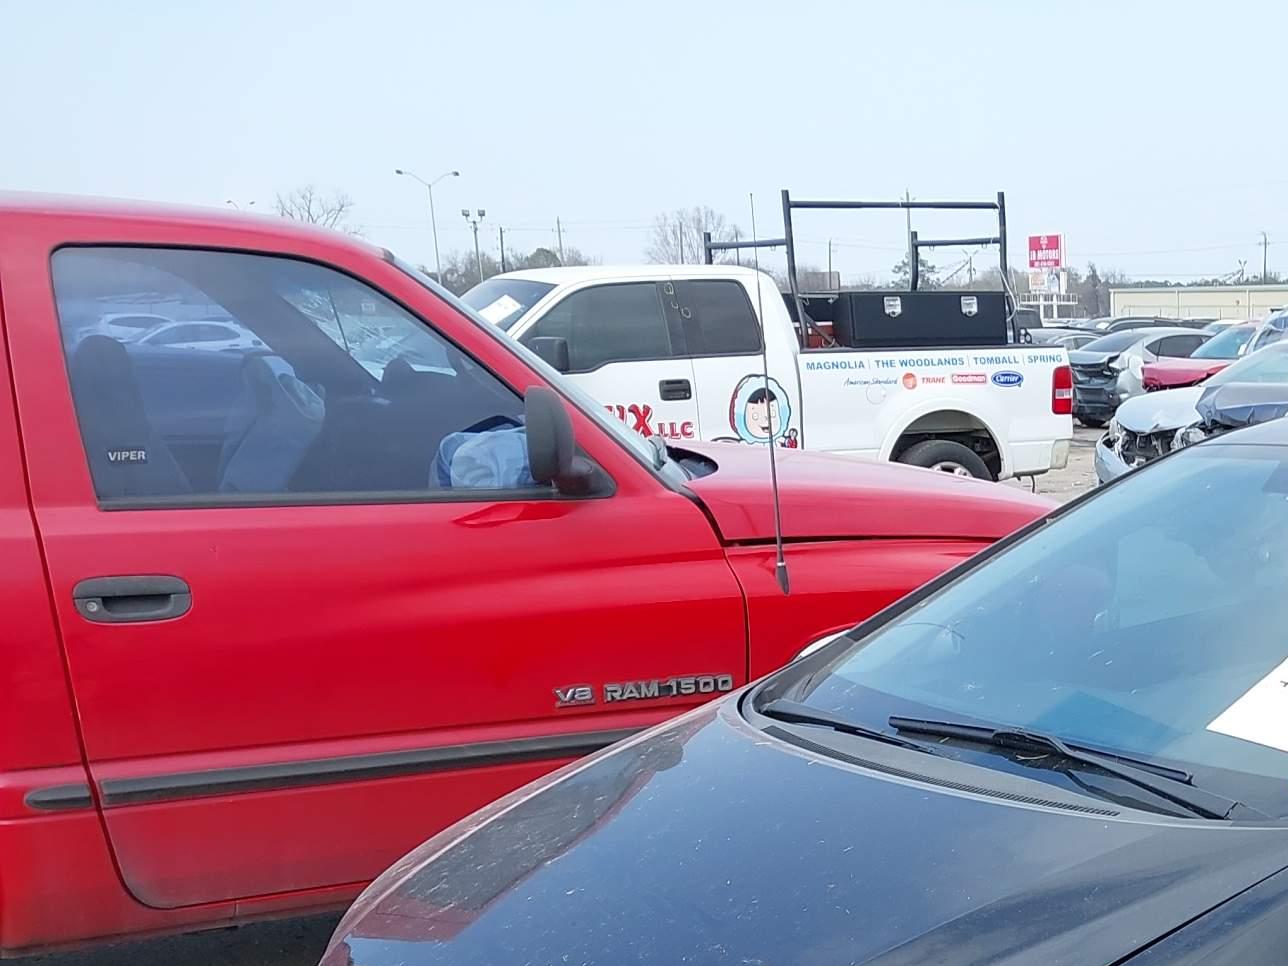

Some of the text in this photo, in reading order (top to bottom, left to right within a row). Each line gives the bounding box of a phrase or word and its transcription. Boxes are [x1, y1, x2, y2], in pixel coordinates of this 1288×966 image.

[805, 353, 1063, 370] MAGNOLIA THE WOODLANDS TOMBALL SPRING
[921, 376, 946, 386] TRANE
[952, 374, 986, 384] Goodman
[995, 373, 1020, 384] Carrier
[657, 421, 695, 440] LLC
[107, 450, 146, 461] VIPER
[555, 674, 733, 702] V8 RAM 1500
